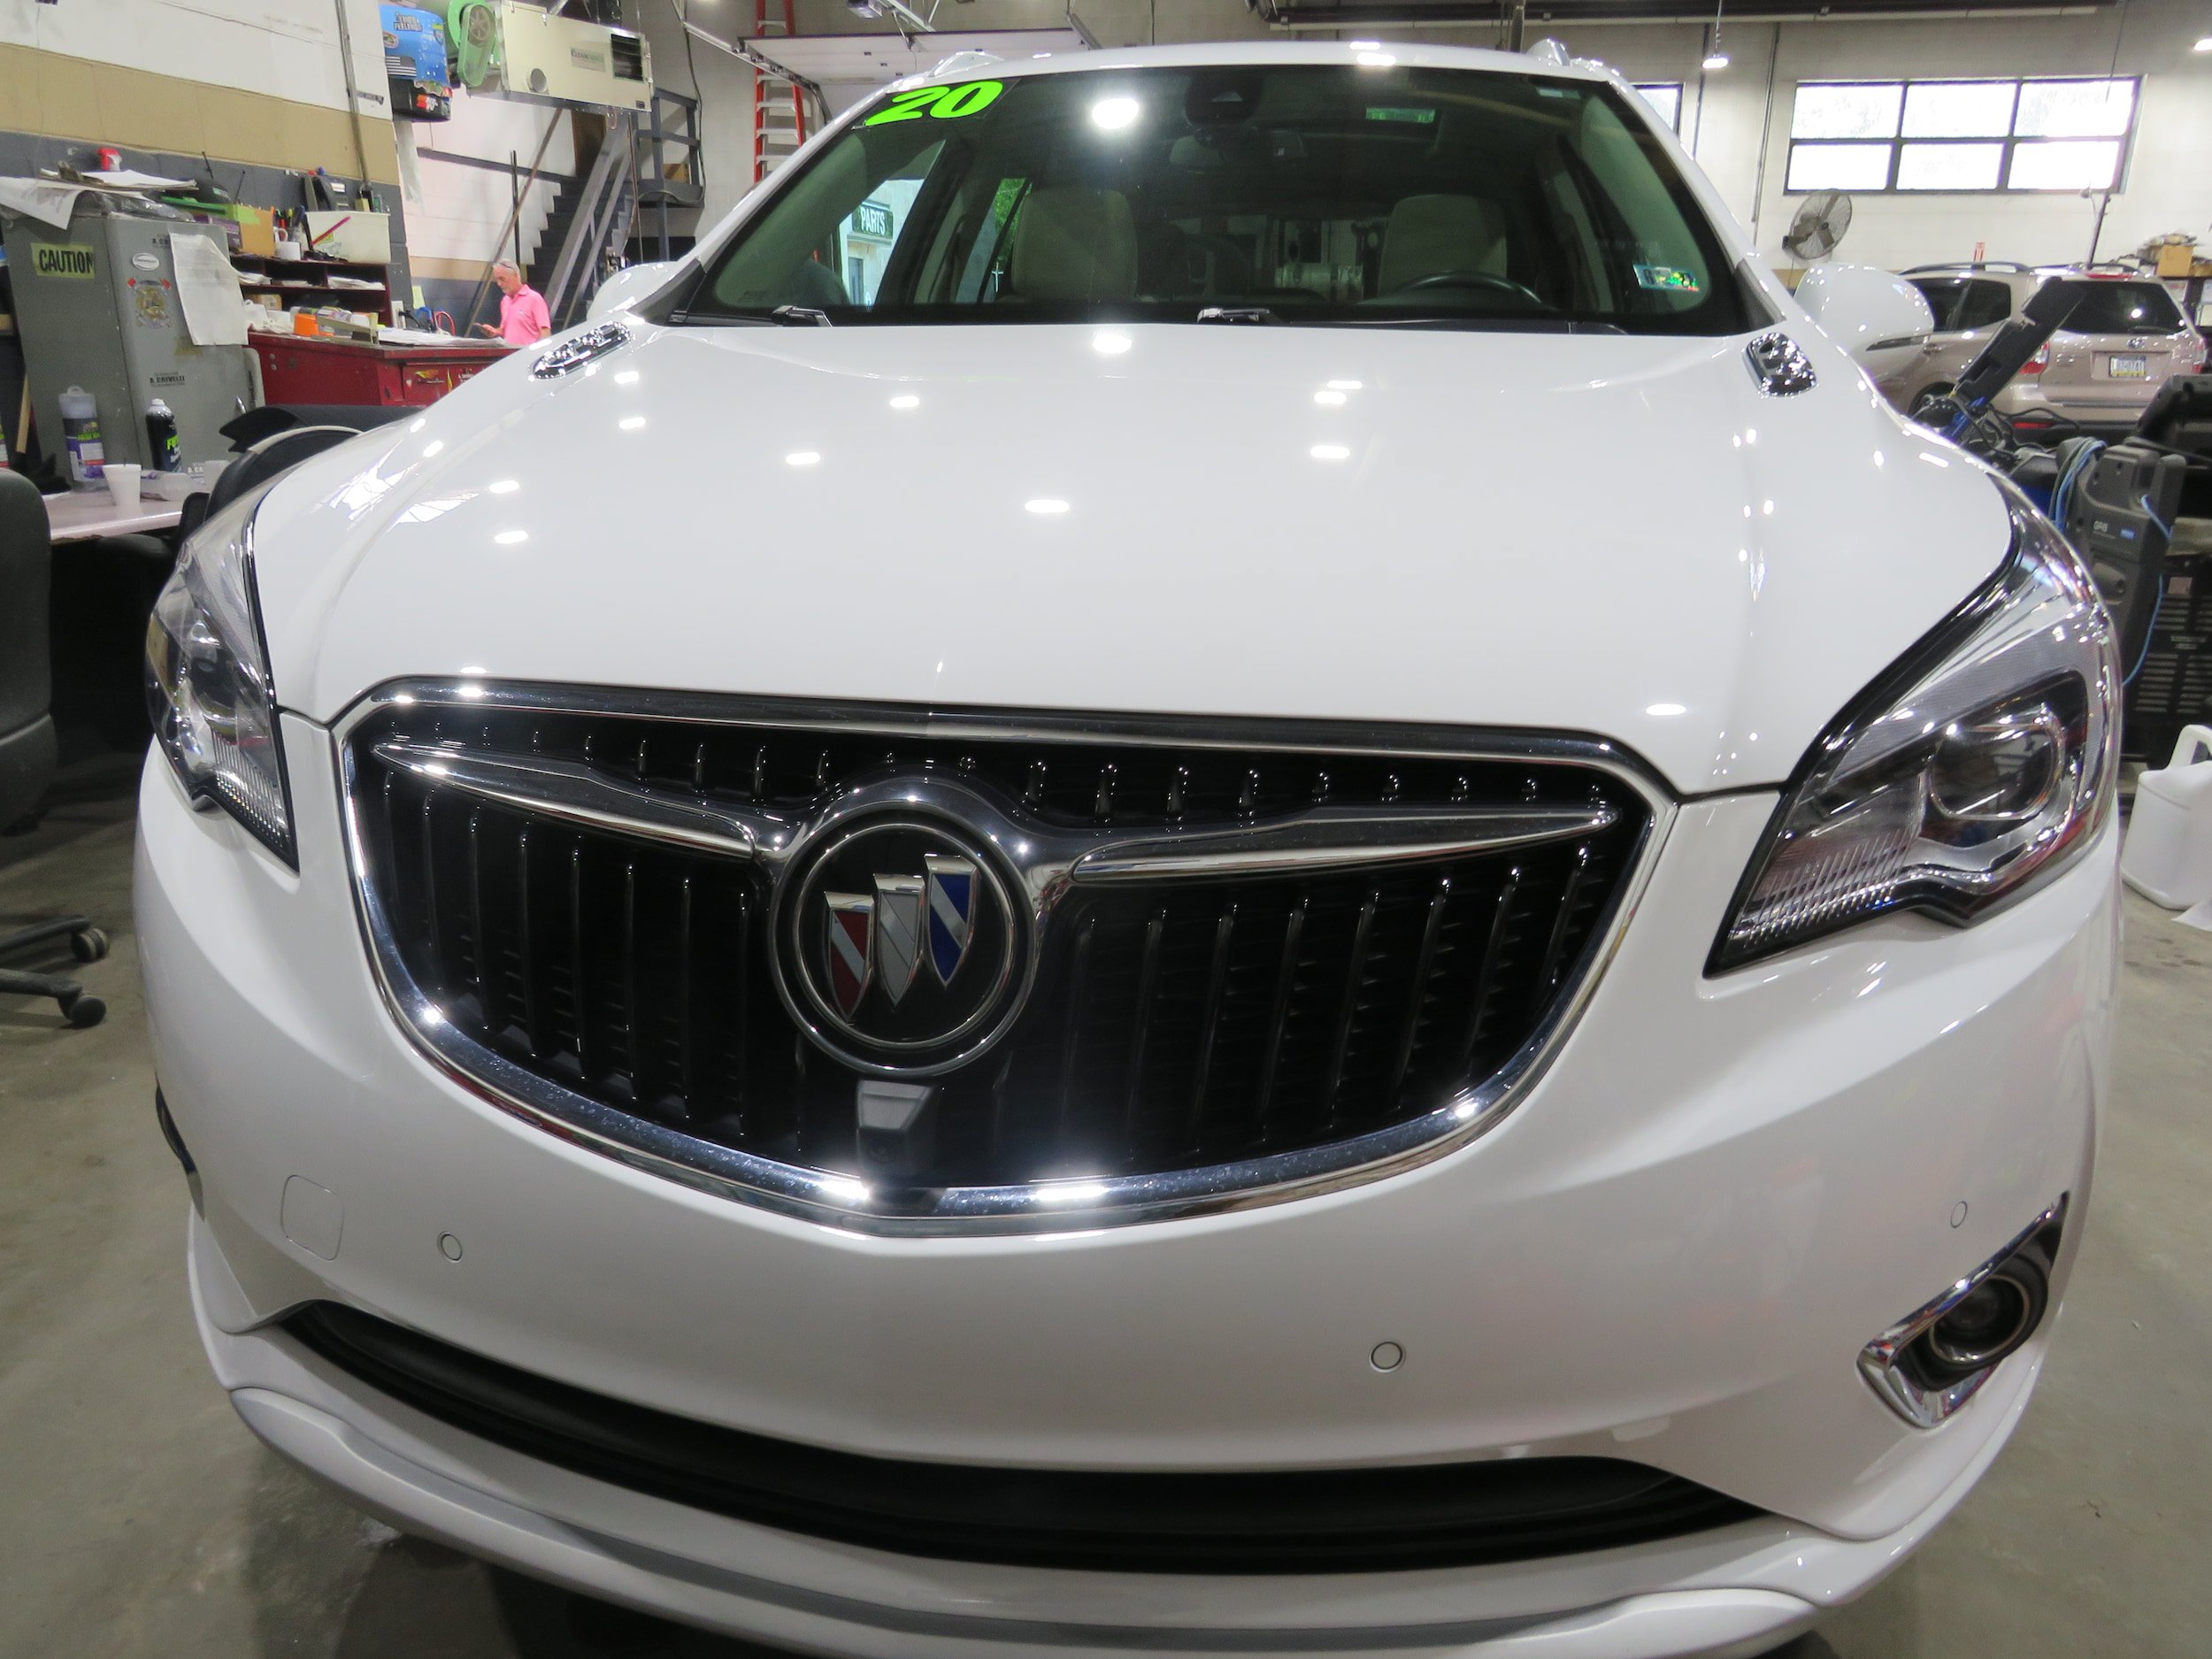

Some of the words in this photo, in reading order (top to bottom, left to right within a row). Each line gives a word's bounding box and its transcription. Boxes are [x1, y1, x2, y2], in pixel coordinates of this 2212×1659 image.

[864, 80, 1003, 127] 20
[860, 205, 886, 234] PARTS
[39, 249, 95, 273] CAUTION
